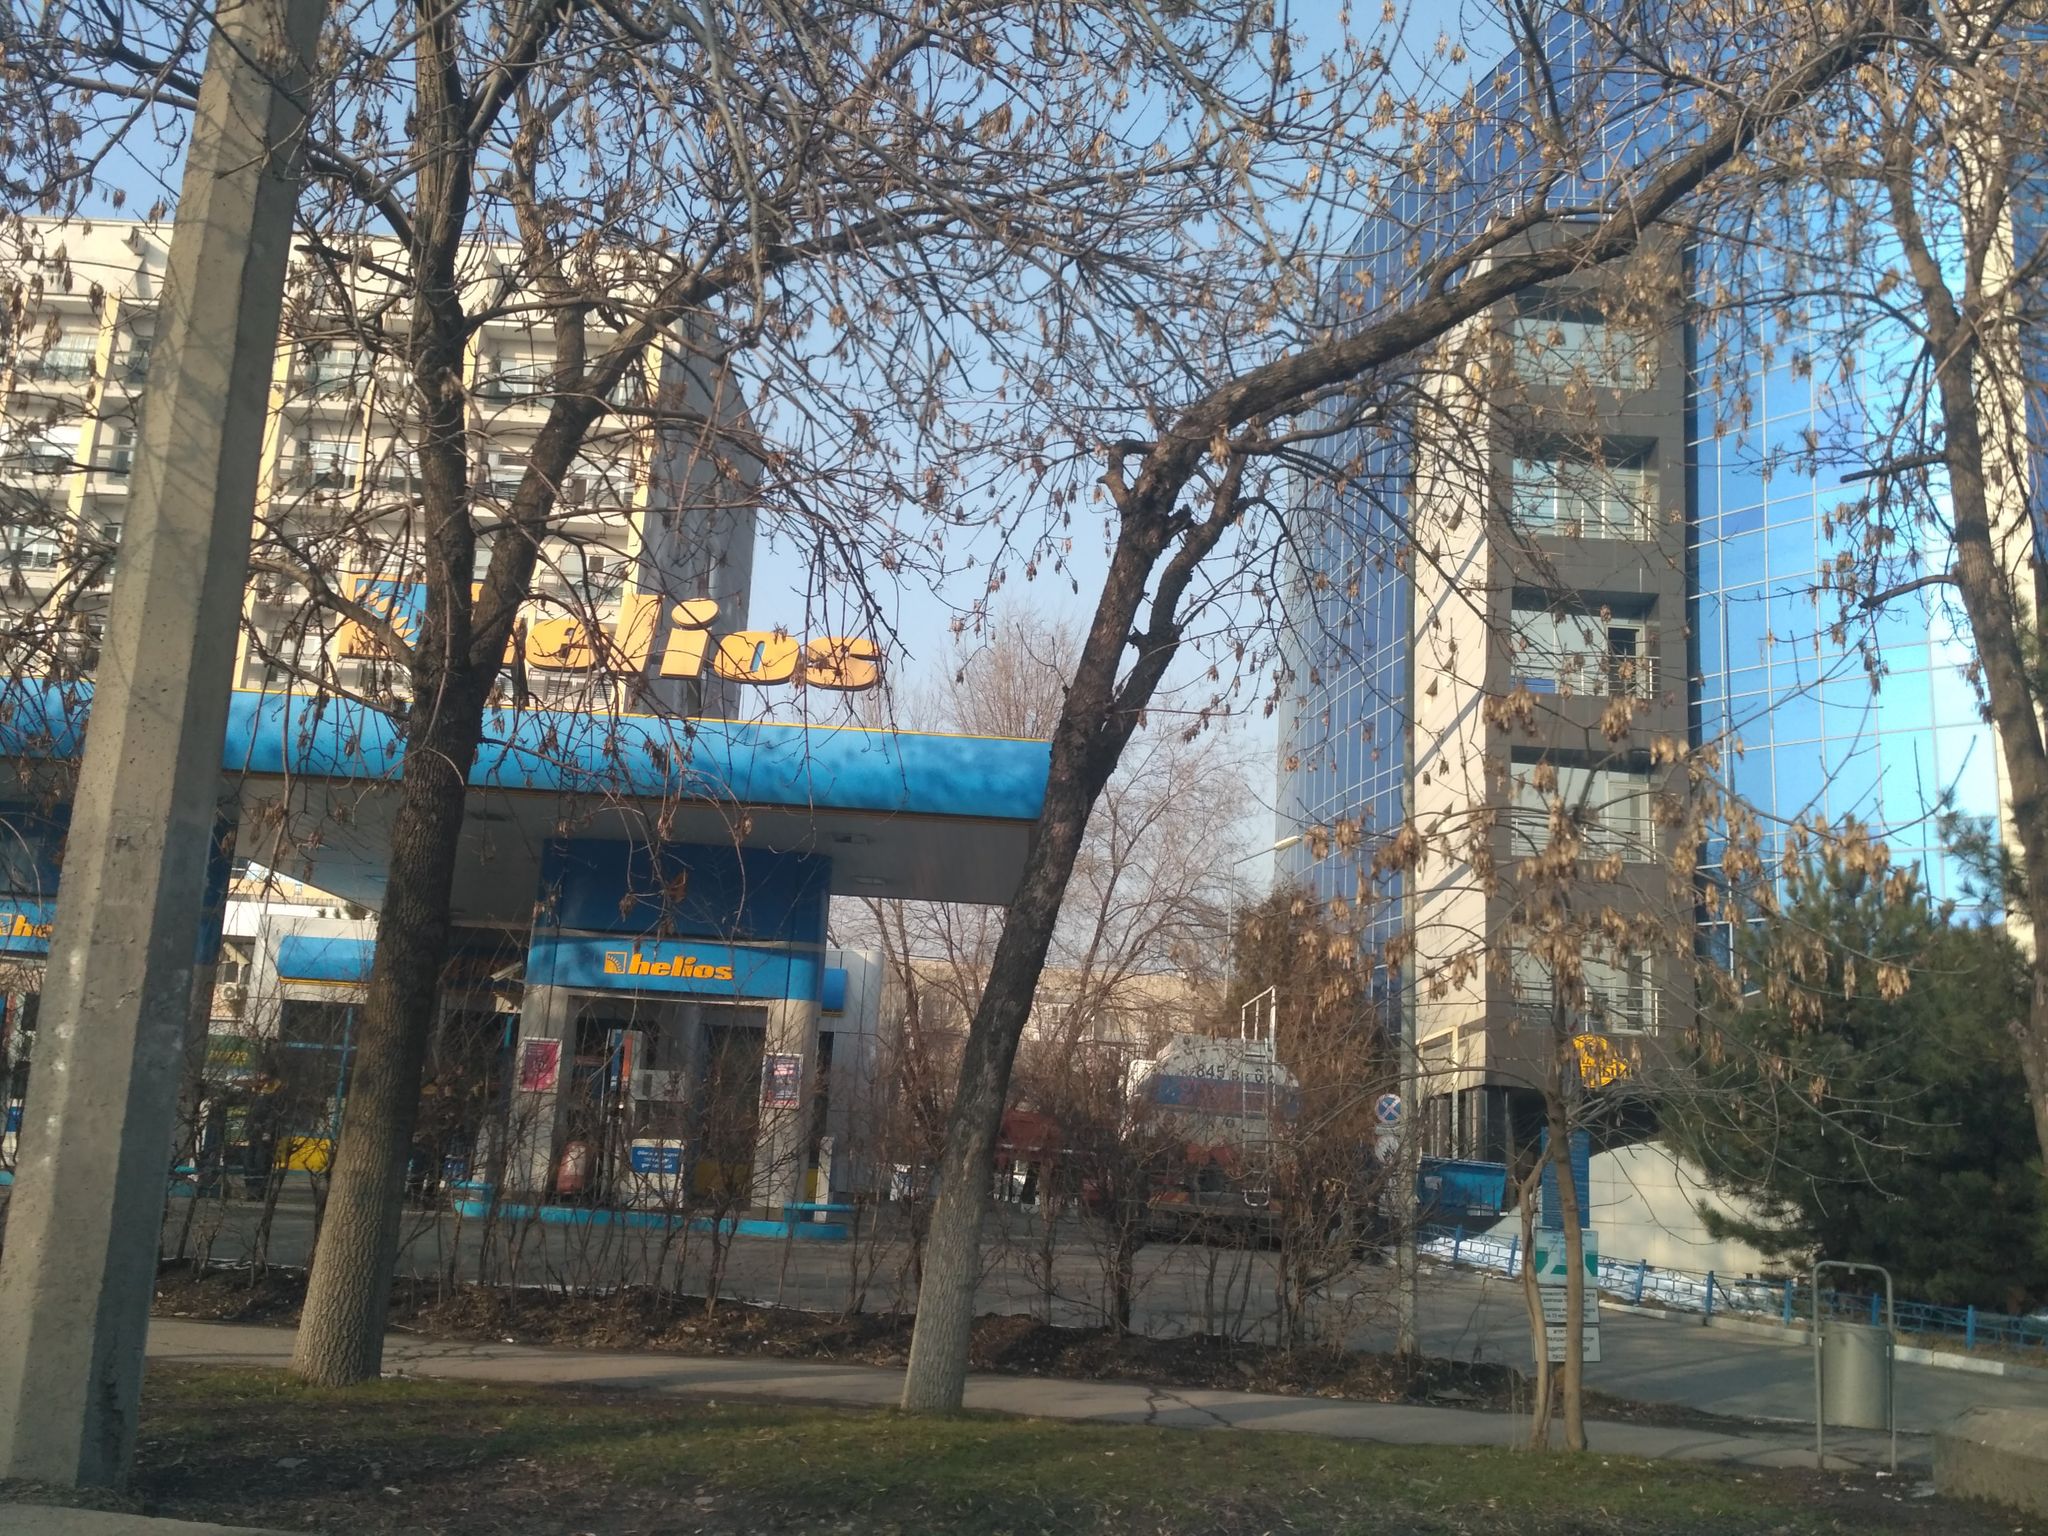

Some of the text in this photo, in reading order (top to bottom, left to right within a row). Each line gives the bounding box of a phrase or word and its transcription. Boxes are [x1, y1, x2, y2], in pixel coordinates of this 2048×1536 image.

[470, 581, 883, 691] elios
[628, 953, 734, 981] helios
[1196, 1063, 1226, 1080] 845
